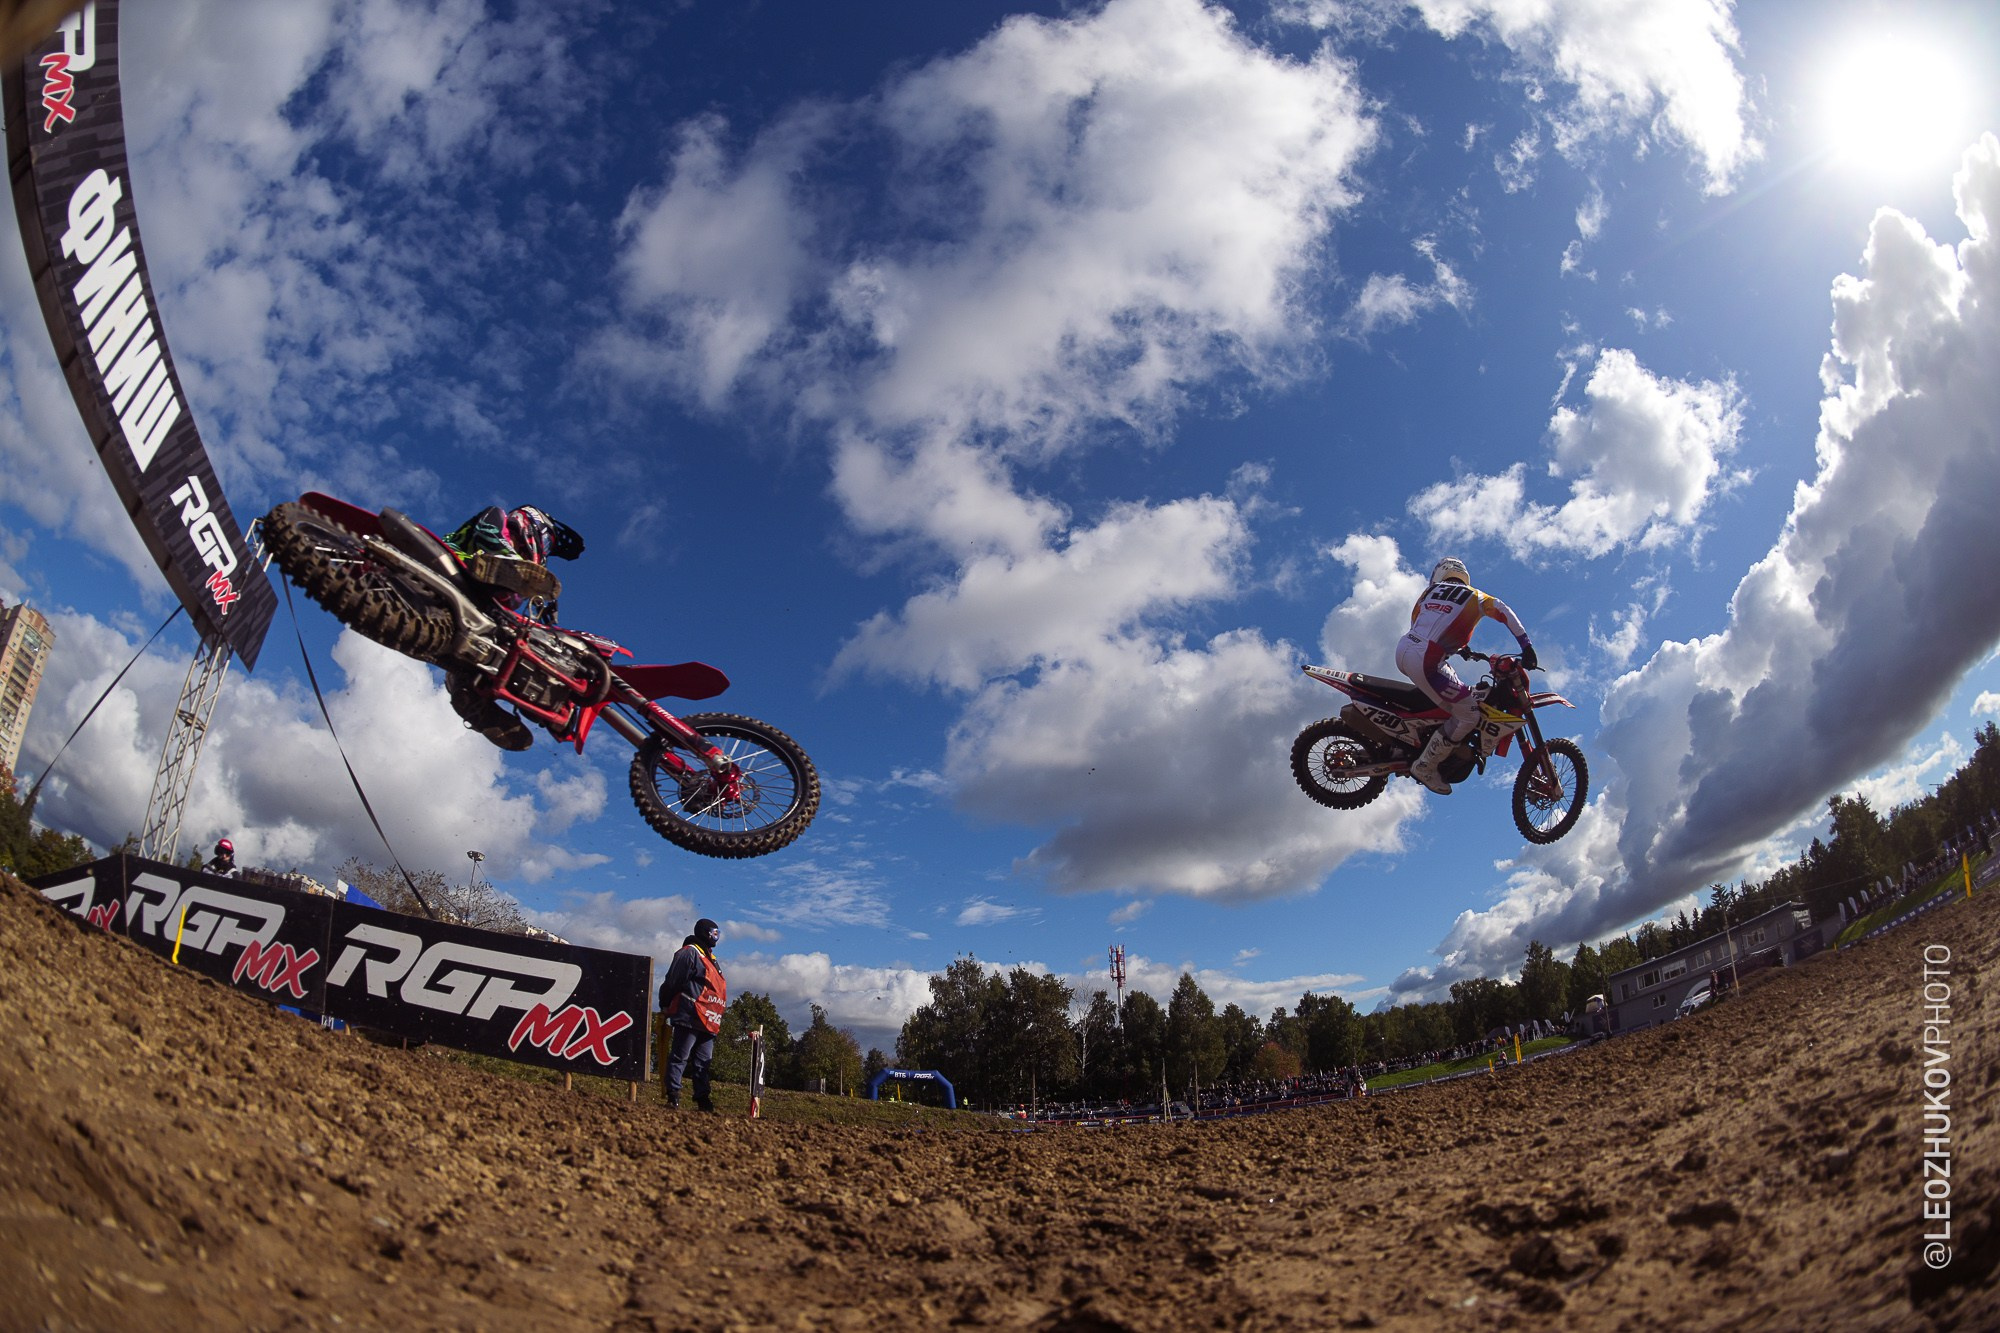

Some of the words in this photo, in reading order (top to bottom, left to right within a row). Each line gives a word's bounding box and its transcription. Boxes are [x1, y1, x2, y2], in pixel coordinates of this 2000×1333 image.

[39, 52, 76, 133] MX
[60, 168, 181, 473] ФИНИШ
[170, 475, 238, 577] RGP
[205, 570, 241, 615] MX
[1367, 707, 1401, 729] 730
[126, 872, 286, 955] RGP
[232, 940, 320, 999] MX
[326, 923, 582, 1020] RGP
[508, 1002, 633, 1065] MX
